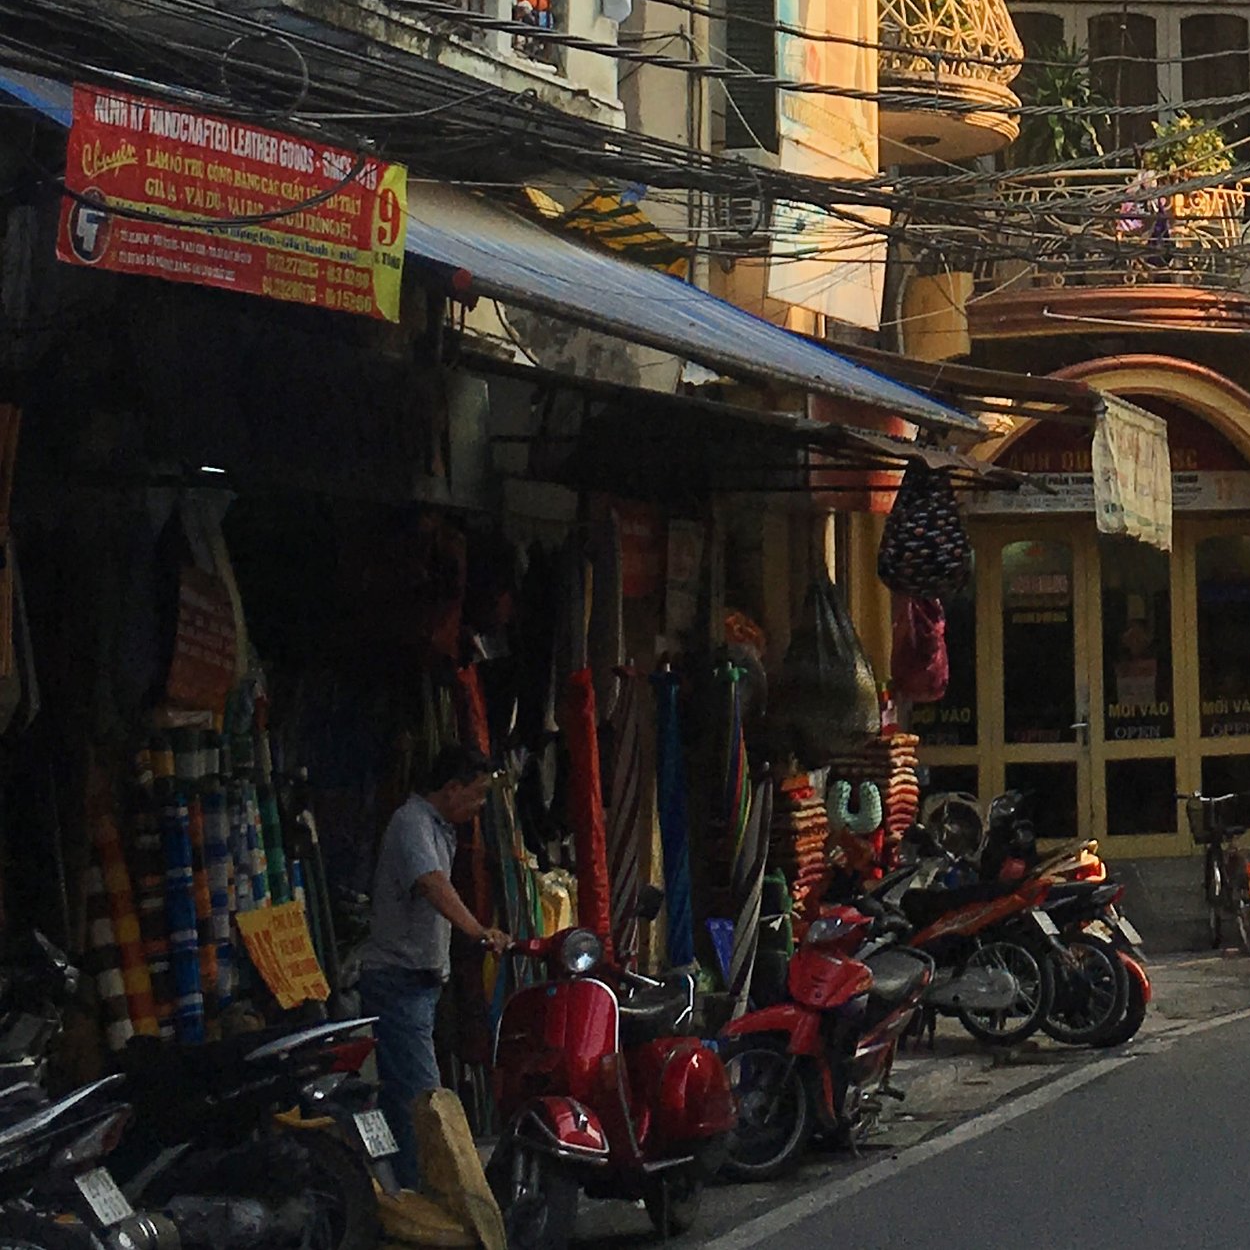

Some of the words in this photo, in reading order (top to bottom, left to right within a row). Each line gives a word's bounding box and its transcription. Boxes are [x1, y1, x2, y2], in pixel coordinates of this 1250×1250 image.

[231, 126, 278, 165] LEATHER
[280, 140, 314, 174] GOODS
[377, 187, 400, 247] 9
[1114, 725, 1161, 738] OPEN
